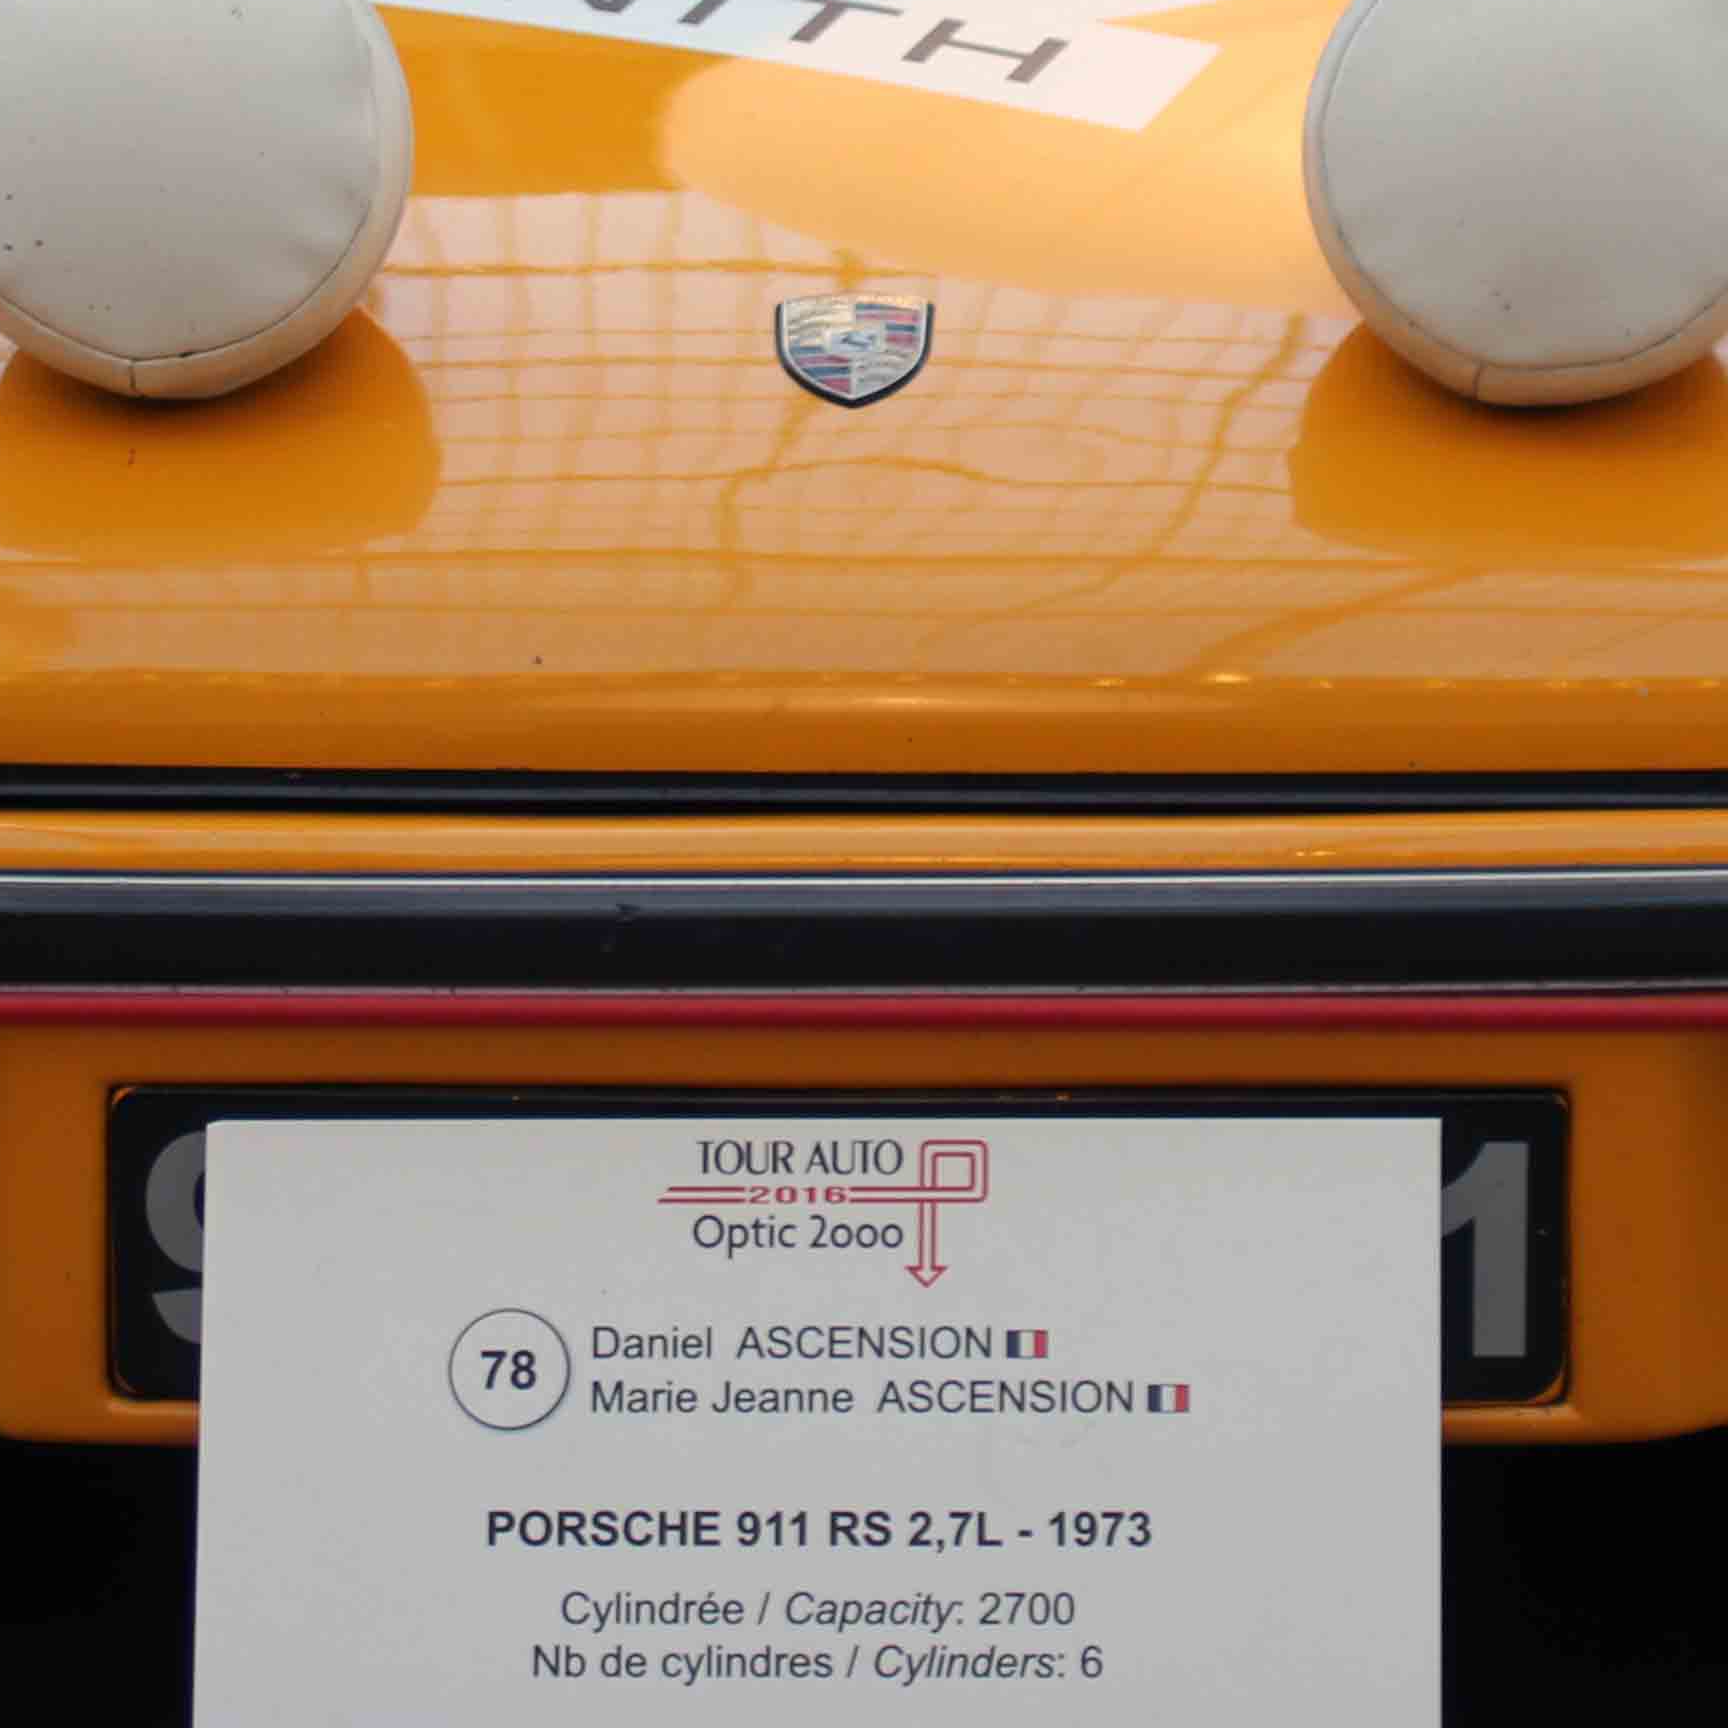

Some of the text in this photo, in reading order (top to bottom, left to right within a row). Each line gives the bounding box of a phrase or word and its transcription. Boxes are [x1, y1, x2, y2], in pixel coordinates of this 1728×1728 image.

[696, 1138, 904, 1176] TOUR AUTO
[749, 1185, 848, 1204] 2016
[692, 1214, 904, 1259] Optic 2000
[592, 1325, 992, 1360] Daniel ASCENSION
[480, 1349, 537, 1391] 78
[591, 1379, 1134, 1414] Marie Jeanne ASCENSION
[487, 1509, 1153, 1554] PORSCHE 911 RS 2,7L - 1973
[561, 1591, 1075, 1635] Cylindrée / Capacity: 2700
[532, 1644, 1103, 1687] Nb de cylindres / Cylinders: 6
